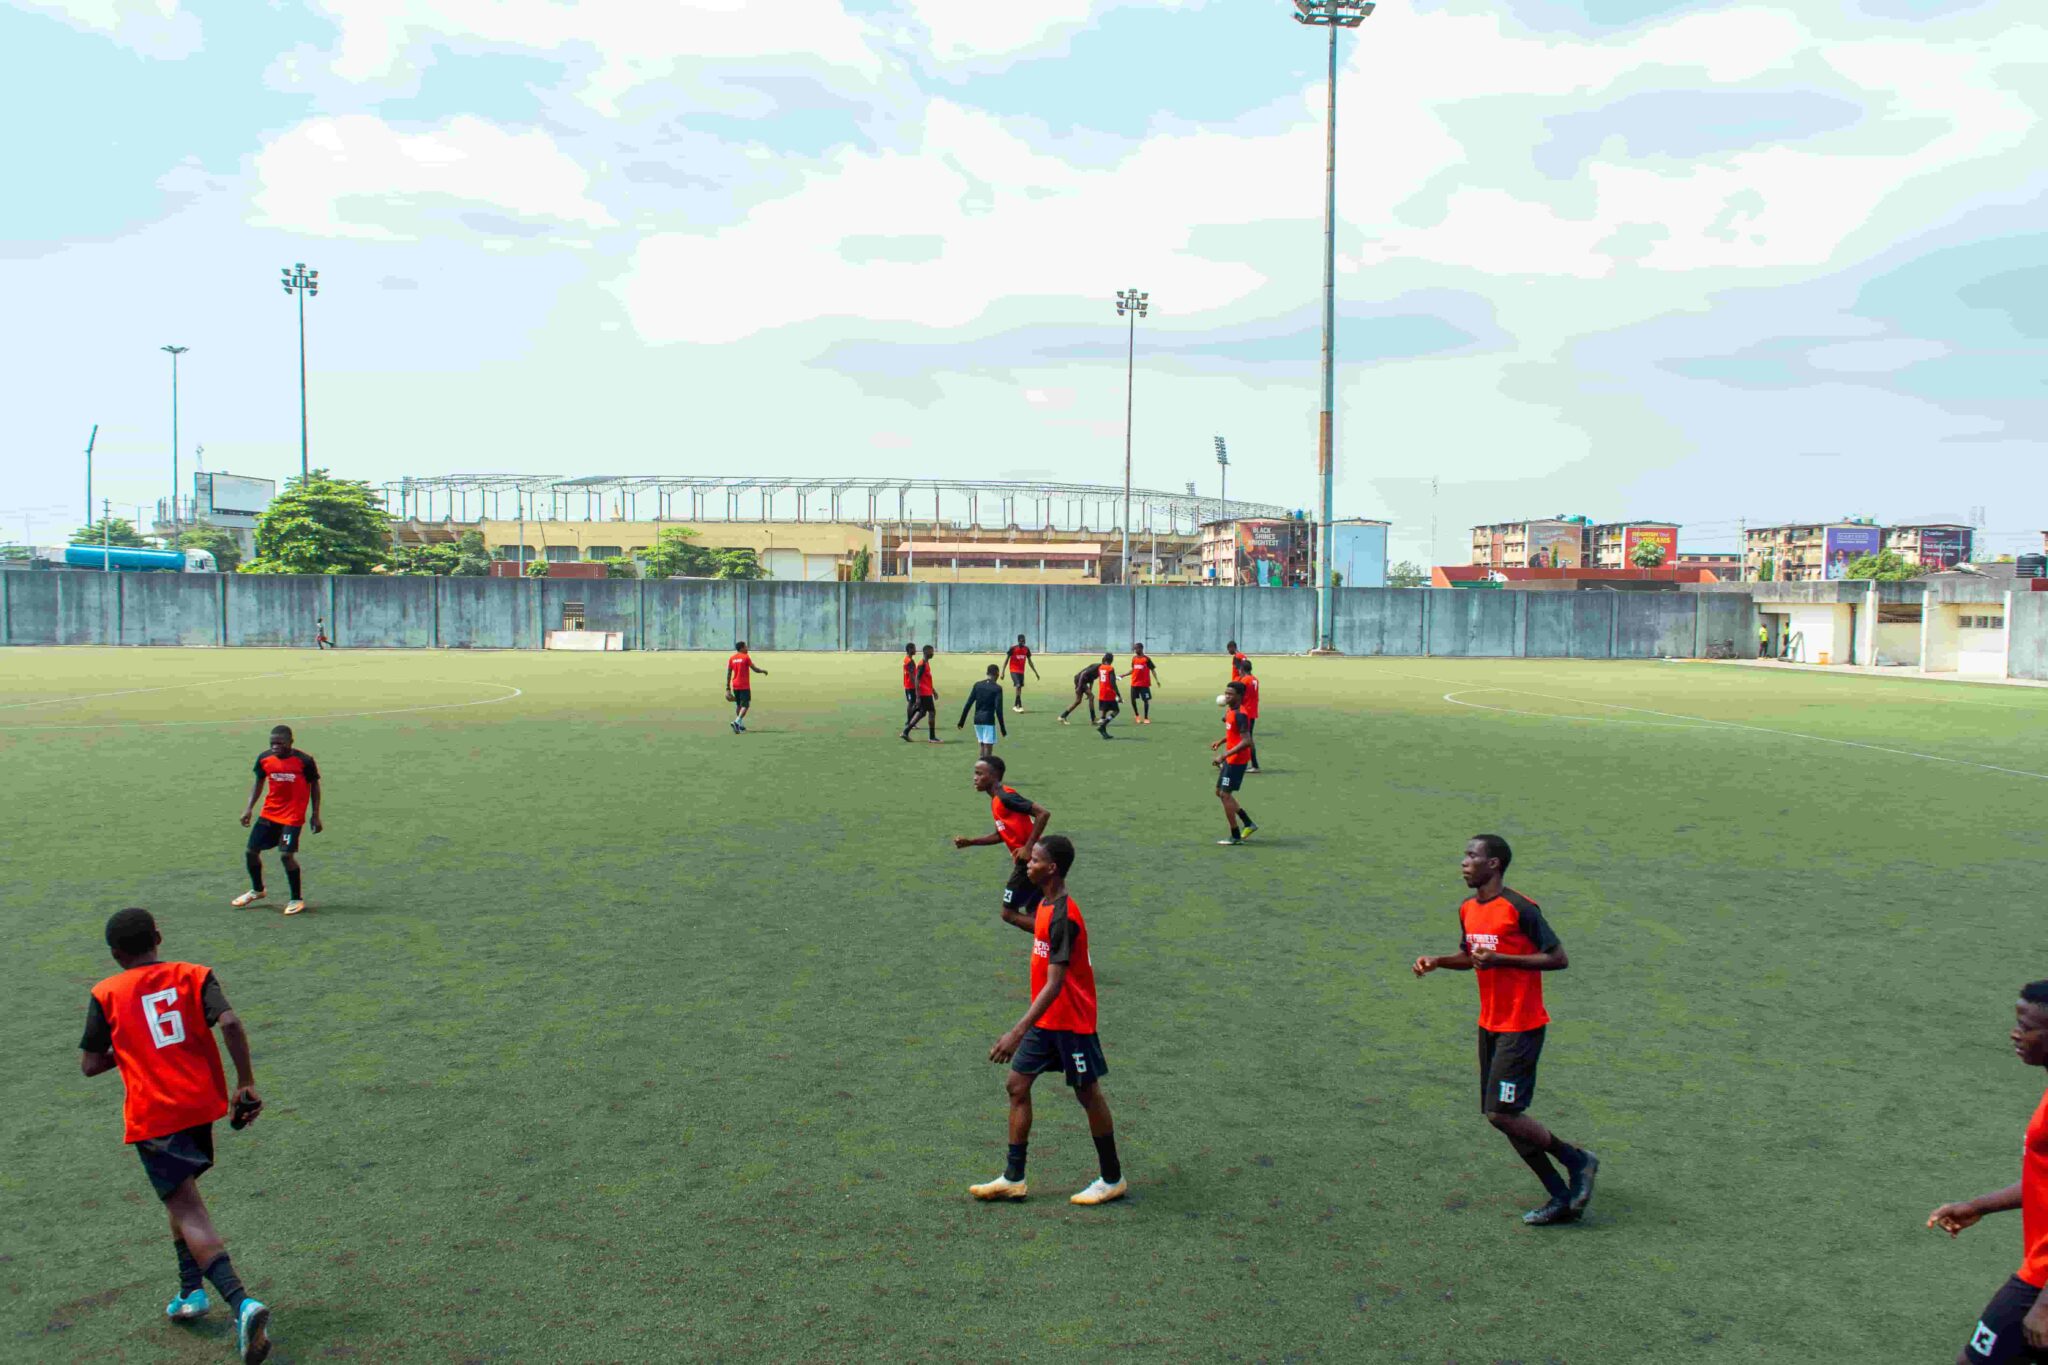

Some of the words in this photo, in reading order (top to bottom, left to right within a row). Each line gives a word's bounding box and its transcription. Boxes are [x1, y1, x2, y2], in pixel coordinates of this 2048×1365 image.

[283, 834, 291, 845] 4
[141, 987, 185, 1049] 6
[1499, 1080, 1516, 1103] 18
[1970, 1319, 1998, 1357] 13
